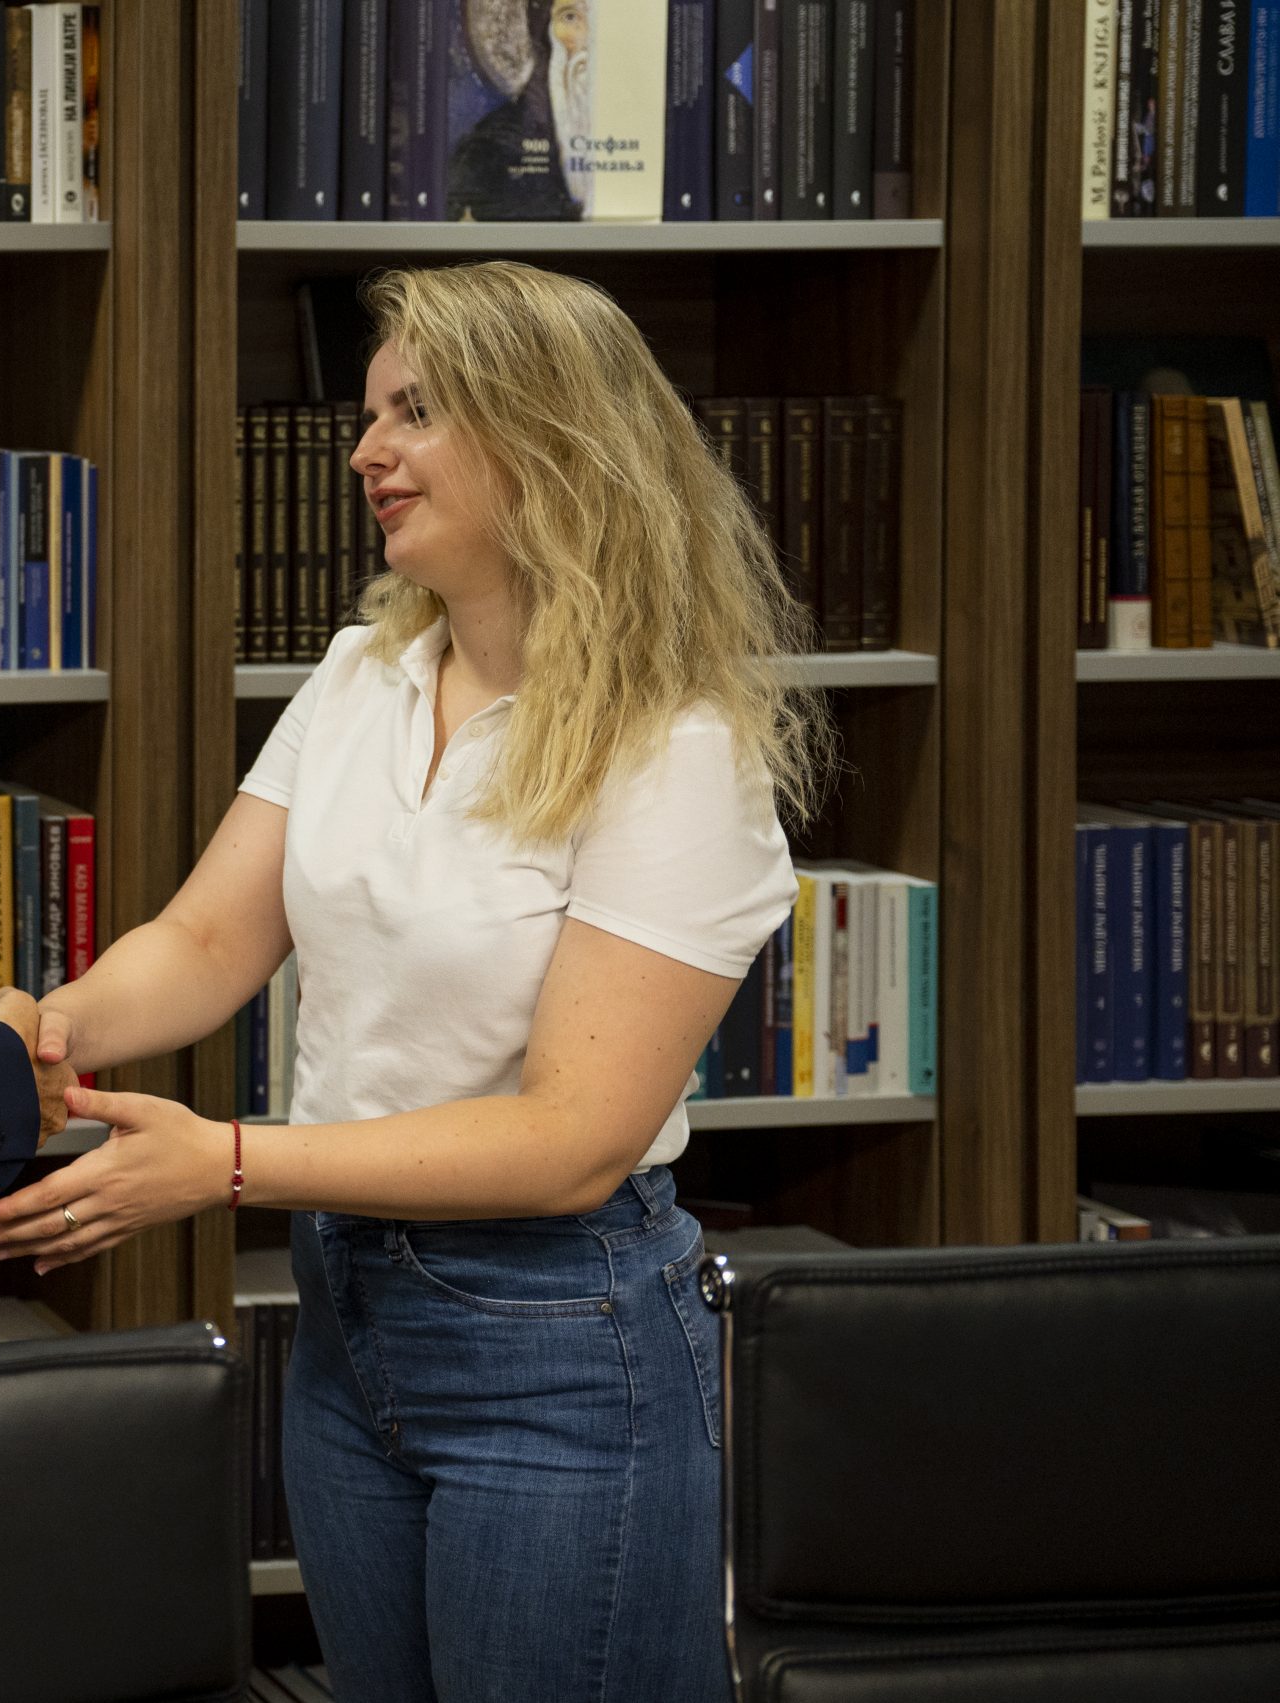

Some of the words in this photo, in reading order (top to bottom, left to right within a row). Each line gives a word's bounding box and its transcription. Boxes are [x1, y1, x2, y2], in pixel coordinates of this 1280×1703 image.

[65, 13, 77, 50] ВАТРЕ
[1093, 15, 1110, 90] KNJIGA
[64, 53, 77, 102] ЛИНИЈИ
[64, 105, 76, 122] НА
[522, 138, 550, 152] 900
[570, 135, 639, 154] Стефан
[570, 157, 644, 172] Немања
[49, 825, 61, 898] ЗИНОВЬЕВ
[74, 864, 87, 890] KAD
[74, 893, 87, 944] MARINA
